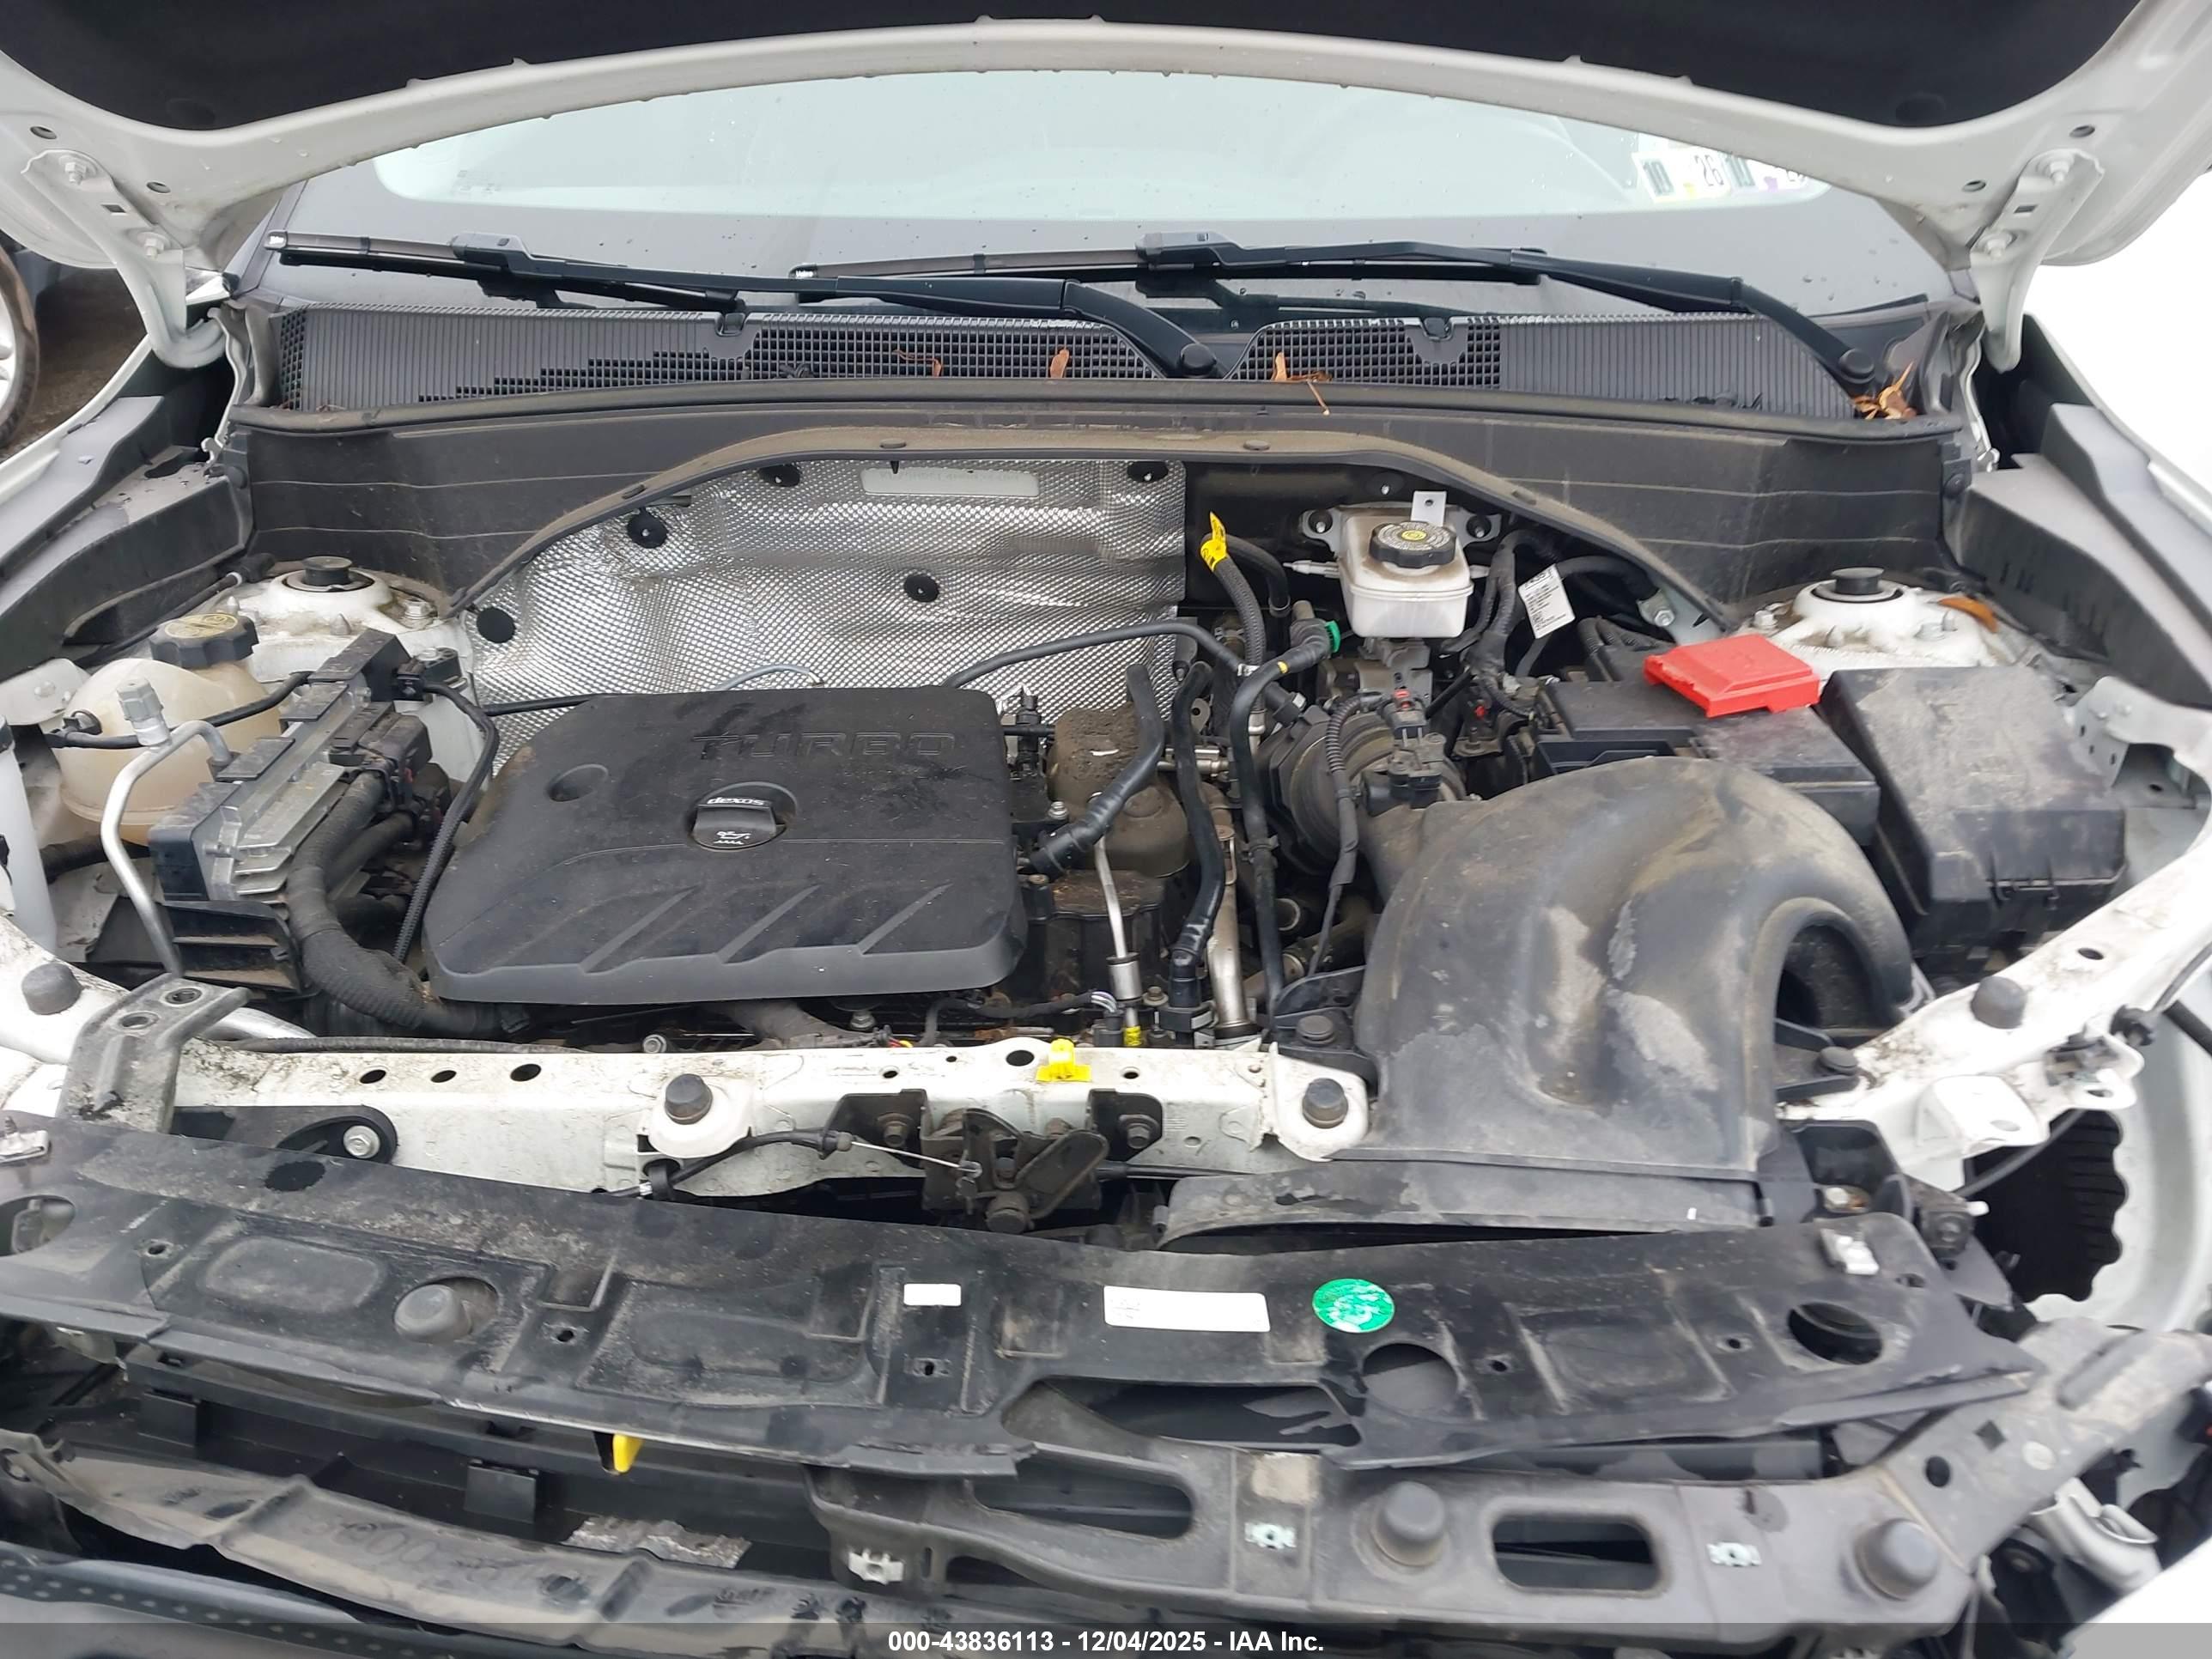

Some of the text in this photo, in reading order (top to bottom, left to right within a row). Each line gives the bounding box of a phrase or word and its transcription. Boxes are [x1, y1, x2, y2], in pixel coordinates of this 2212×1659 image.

[1693, 154, 1724, 187] 26
[692, 731, 956, 760] TURBO
[706, 796, 766, 806] dexos
